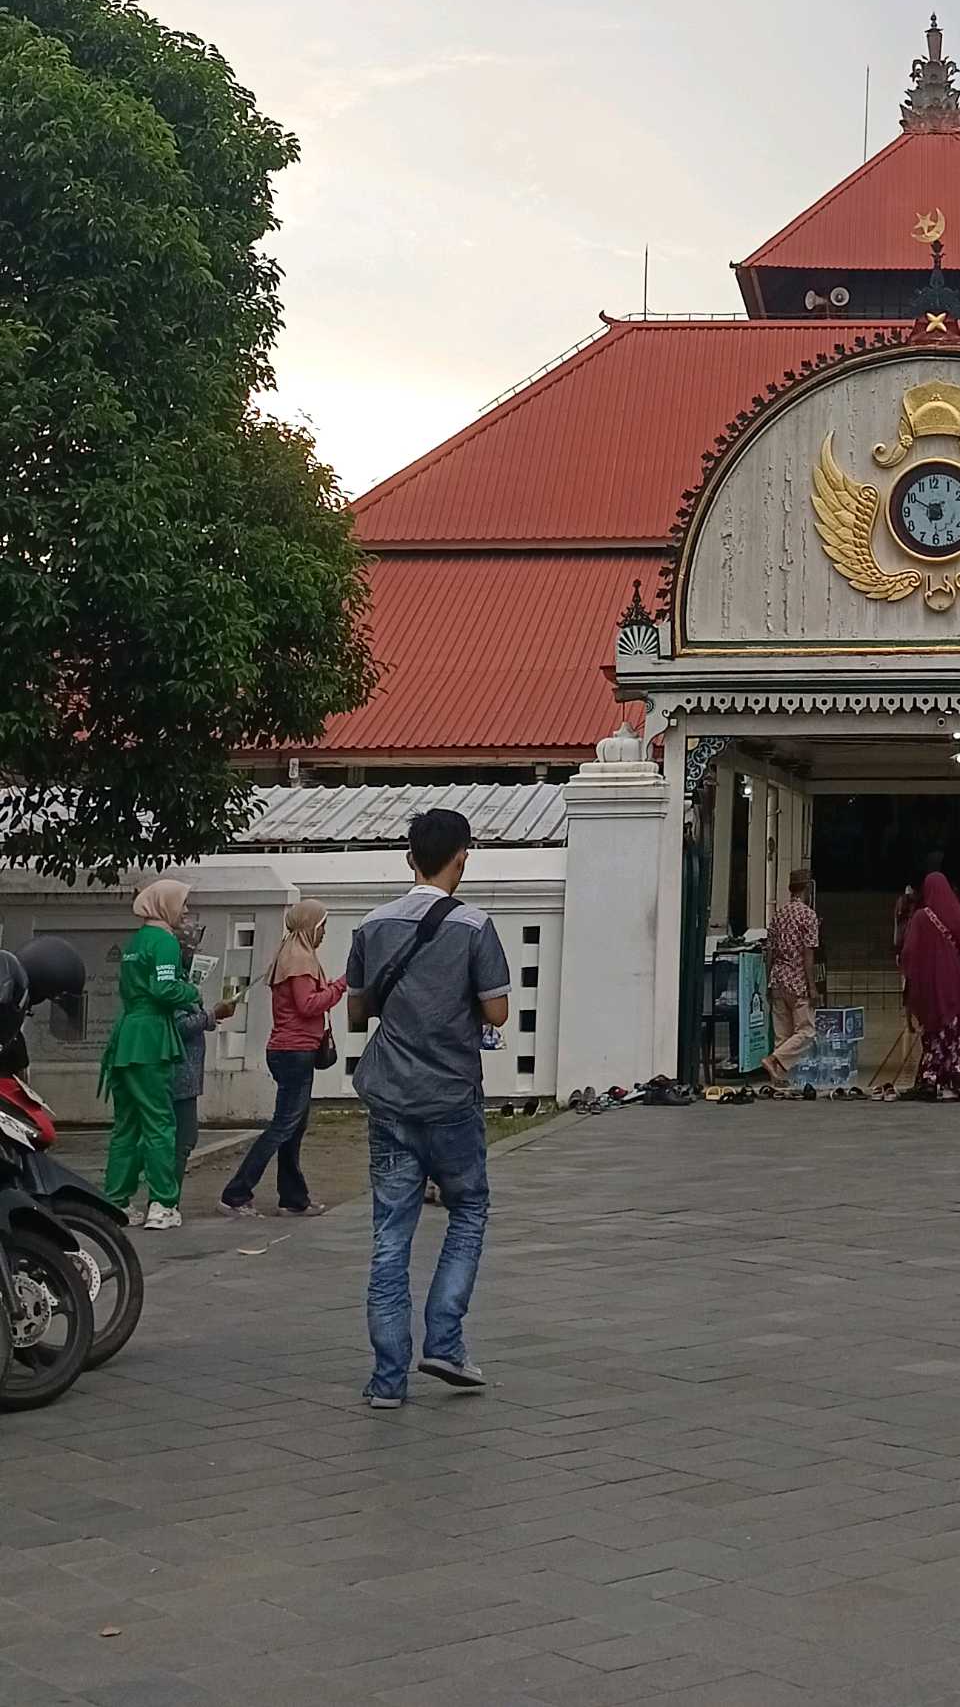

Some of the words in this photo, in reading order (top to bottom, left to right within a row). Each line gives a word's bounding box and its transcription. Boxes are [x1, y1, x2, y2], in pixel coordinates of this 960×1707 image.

[918, 481, 925, 493] 11
[929, 476, 939, 489] 12
[908, 492, 916, 504] 10
[904, 506, 910, 518] 9
[908, 520, 915, 532] 8
[920, 532, 926, 542] 7
[932, 534, 940, 545] 6
[946, 530, 953, 542] 5
